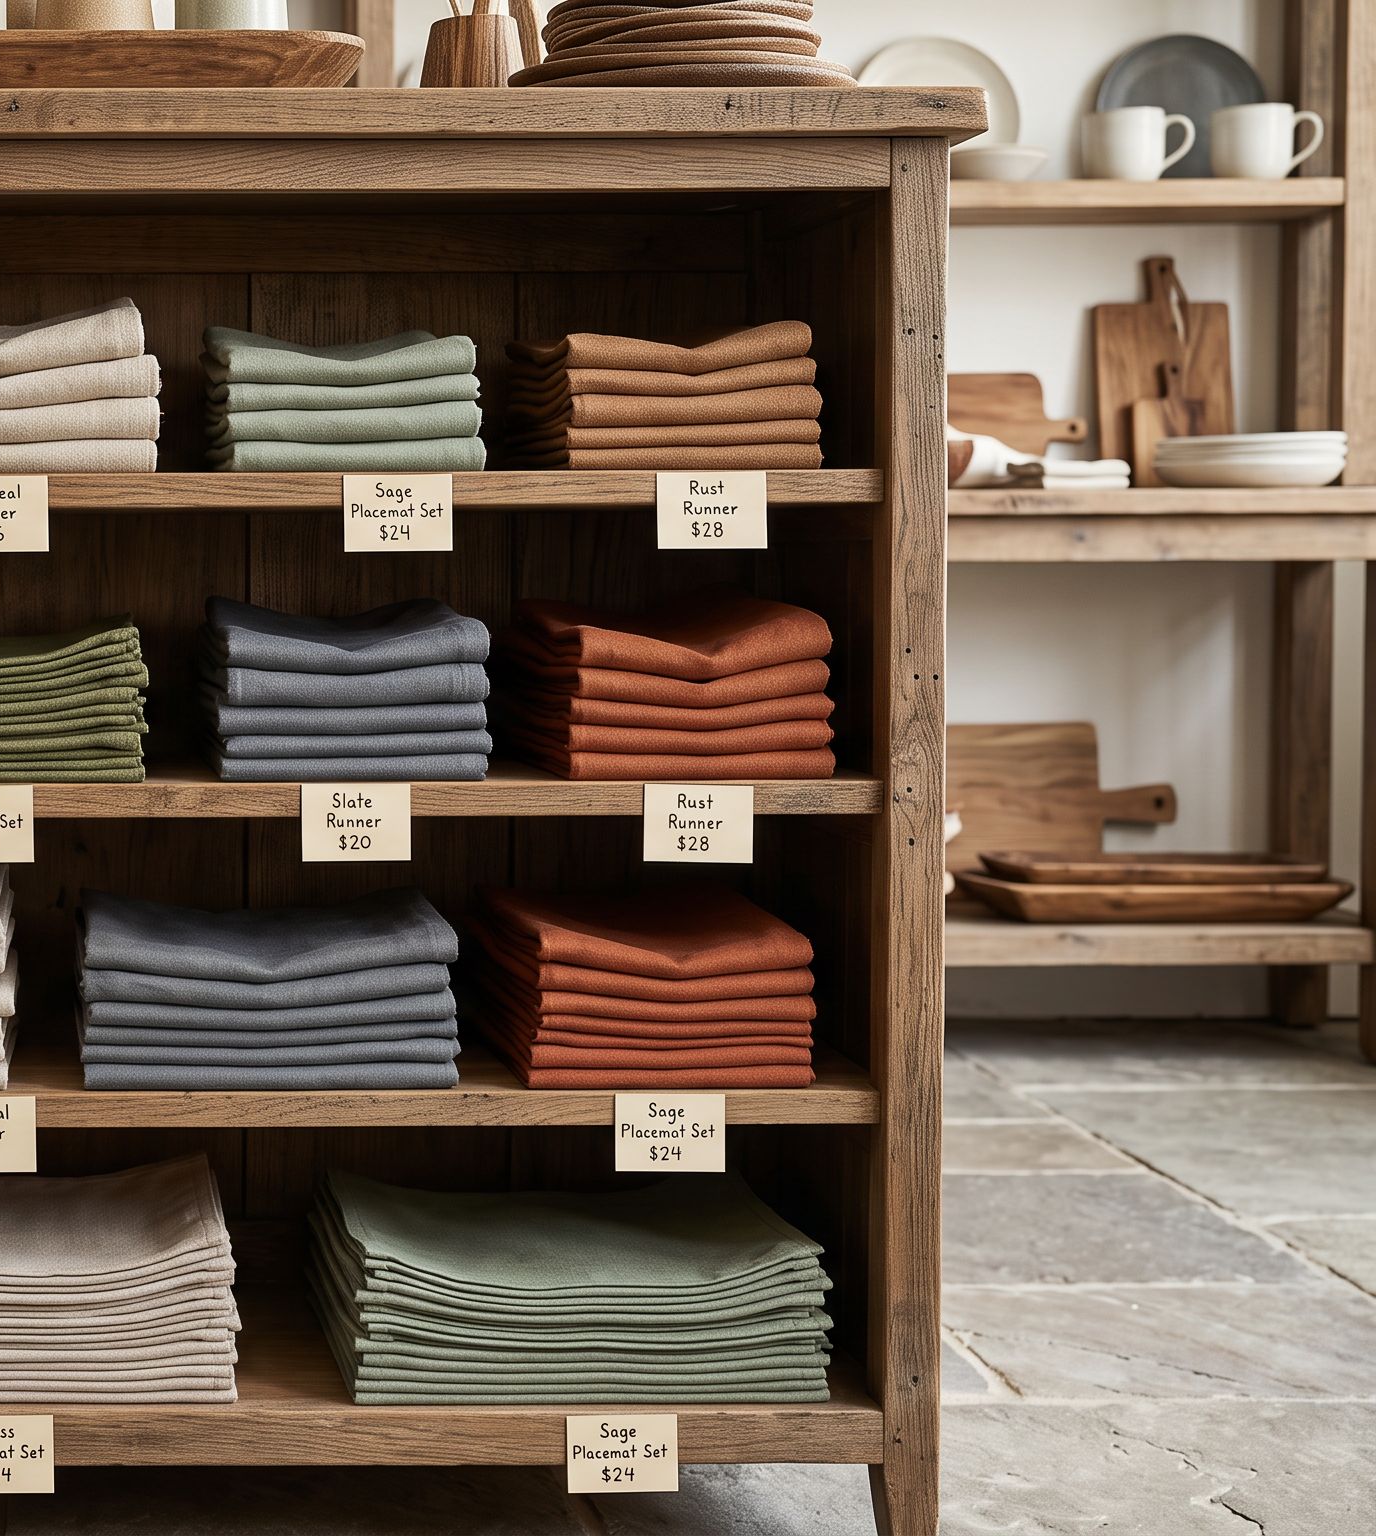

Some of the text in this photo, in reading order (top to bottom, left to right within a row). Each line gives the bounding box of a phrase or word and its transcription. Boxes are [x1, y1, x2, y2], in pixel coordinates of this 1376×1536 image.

[375, 482, 413, 504] Sage
[689, 479, 725, 496] Rust
[351, 502, 444, 519] Placemat Set
[683, 500, 739, 516] Runner
[379, 524, 410, 542] $24
[691, 521, 724, 538] $28
[332, 792, 373, 809] Slate
[677, 793, 714, 810] Rust
[0, 813, 24, 829] Set
[326, 812, 382, 829] Runner
[668, 813, 723, 830] Runner
[338, 834, 372, 851] $20
[676, 835, 710, 852] $28
[648, 1101, 685, 1125] Sage
[621, 1122, 716, 1139] Placemat Set
[649, 1145, 682, 1162] $24
[599, 1422, 637, 1444] Sage
[19, 1444, 45, 1459] Set
[572, 1443, 668, 1460] Placemat Set
[601, 1465, 635, 1483] $24
